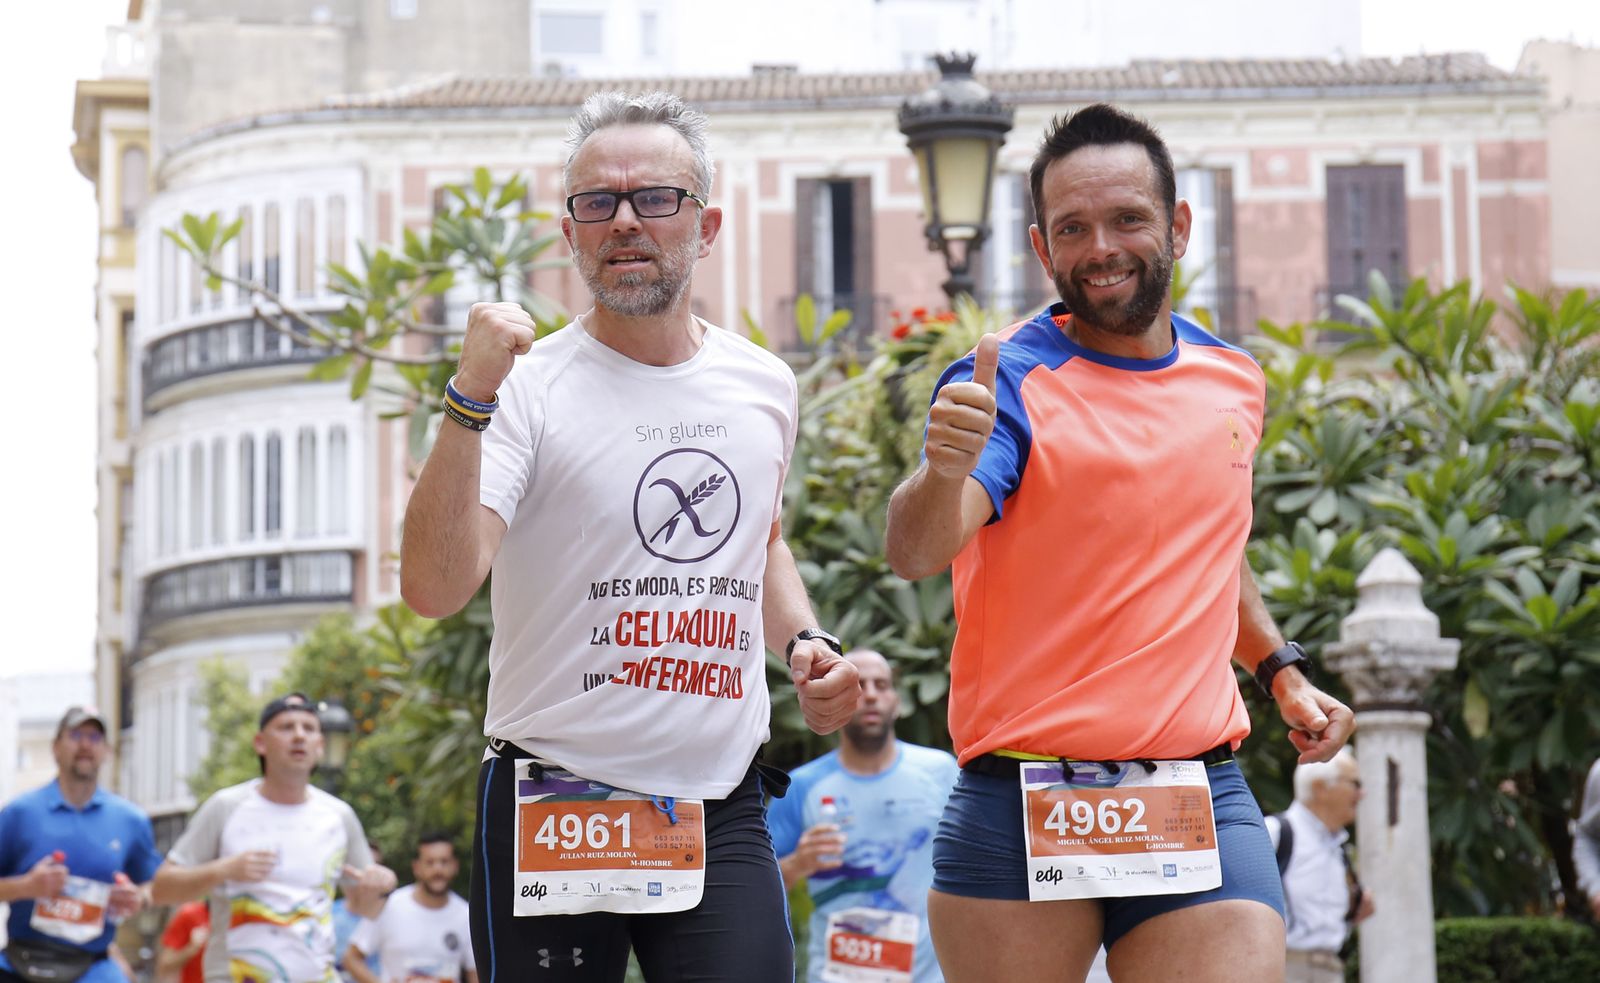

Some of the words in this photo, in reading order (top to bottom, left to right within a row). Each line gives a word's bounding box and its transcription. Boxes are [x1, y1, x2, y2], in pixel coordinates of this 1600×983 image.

[635, 424, 664, 442] Sin
[669, 421, 728, 444] gluten
[588, 581, 608, 601] NO
[611, 578, 631, 597] ES
[635, 576, 683, 599] MODA,
[686, 577, 705, 597] ES
[709, 576, 730, 597] POR
[590, 626, 611, 646] LA
[615, 608, 737, 651] CELIAQUIA
[739, 629, 751, 652] ES
[1043, 797, 1148, 836] 4962
[534, 812, 632, 851] 4961
[1088, 836, 1114, 845] ÁNGEL
[1115, 836, 1134, 844] RUIZ
[1134, 834, 1165, 843] MOLINA
[559, 852, 586, 860] JULIAN
[606, 851, 637, 859] MOLINA
[1145, 842, 1185, 850] L-HOMBRE
[630, 859, 673, 867] M-HOMBRE
[1035, 865, 1064, 886] edp
[520, 881, 548, 901] edp
